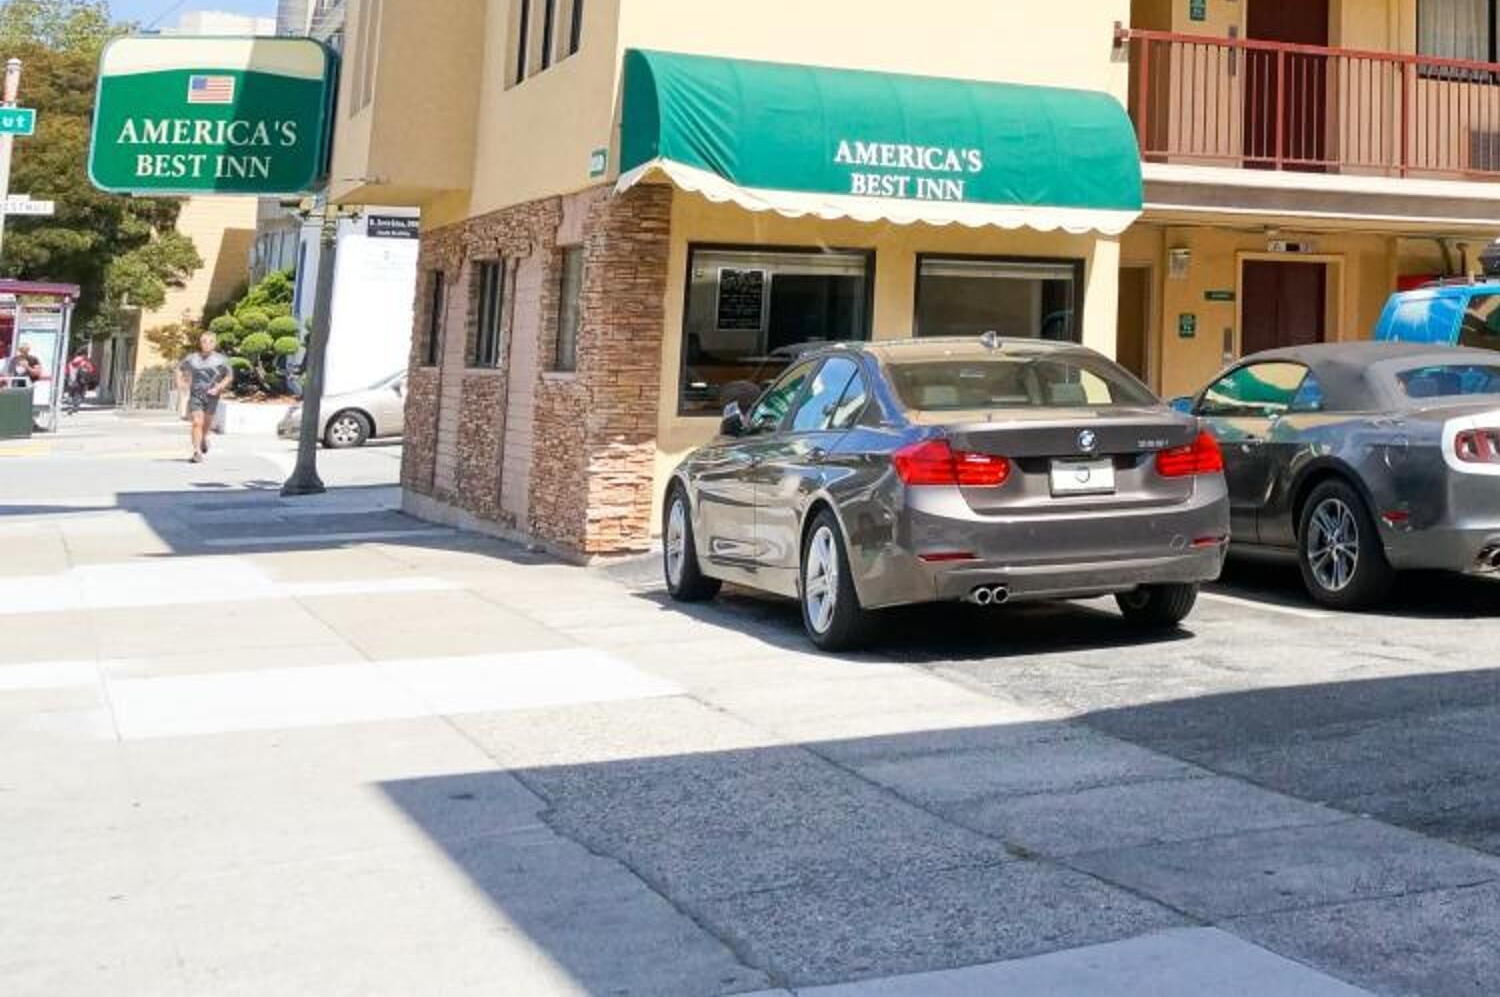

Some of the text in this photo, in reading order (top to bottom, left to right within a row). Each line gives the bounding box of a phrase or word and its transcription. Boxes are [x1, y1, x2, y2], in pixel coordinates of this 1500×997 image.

[117, 118, 297, 147] AMERICA'S
[136, 154, 272, 179] BEST INN
[834, 140, 983, 172] AMERICA'S
[851, 172, 965, 200] BEST INN
